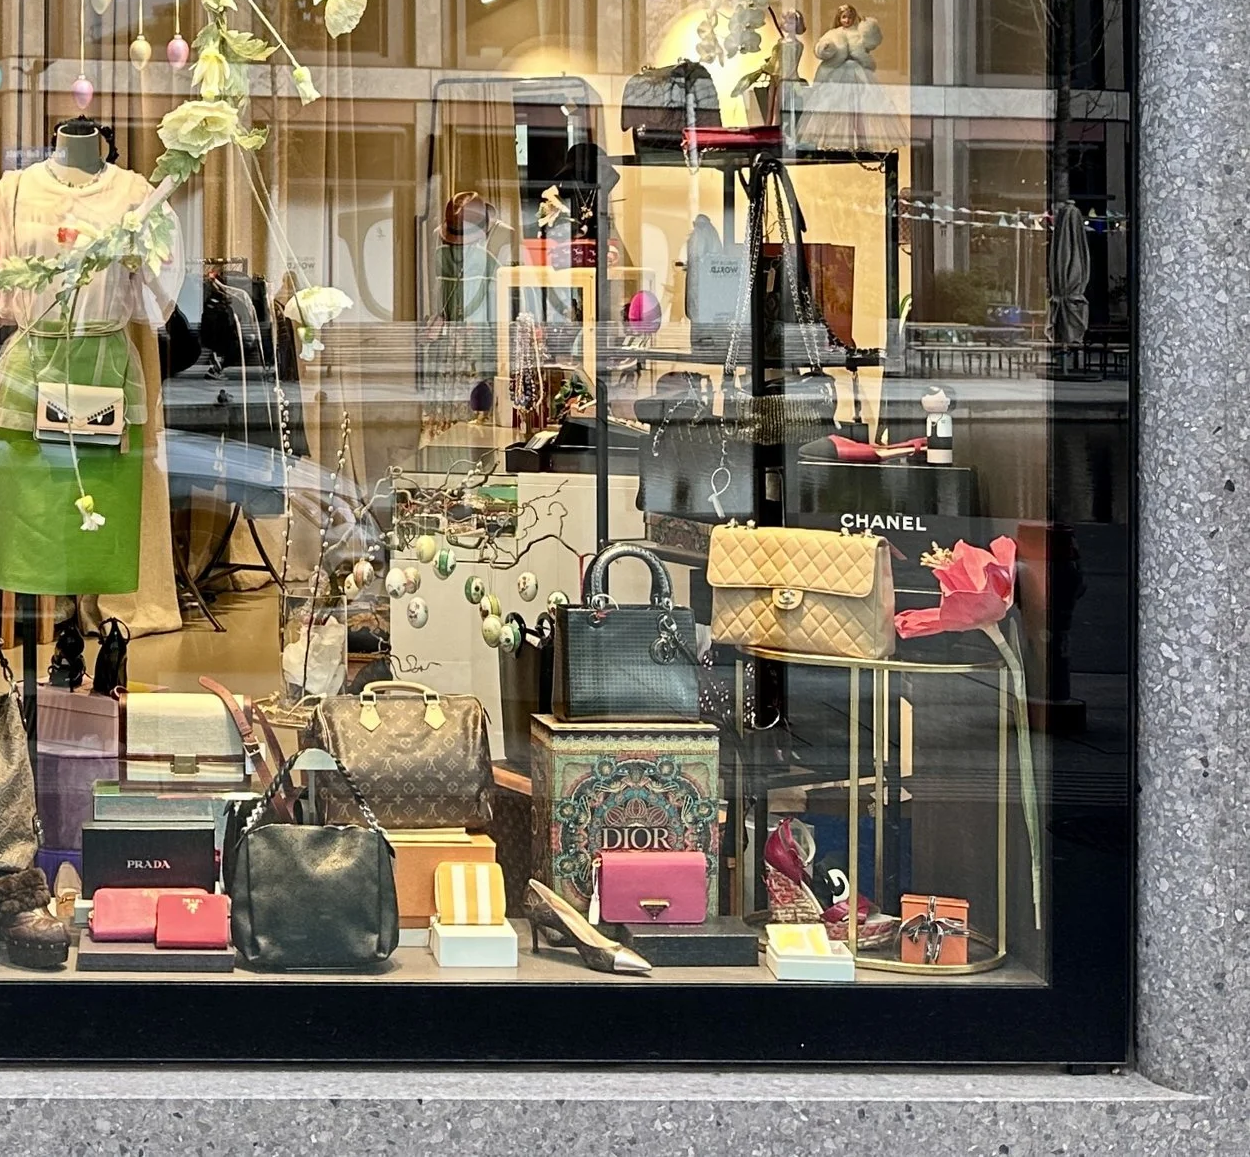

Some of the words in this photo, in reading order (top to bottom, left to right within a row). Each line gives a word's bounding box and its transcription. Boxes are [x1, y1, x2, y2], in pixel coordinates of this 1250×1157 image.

[840, 512, 928, 532] CHANEL
[601, 827, 672, 851] DIOR
[126, 859, 171, 870] PRADA
